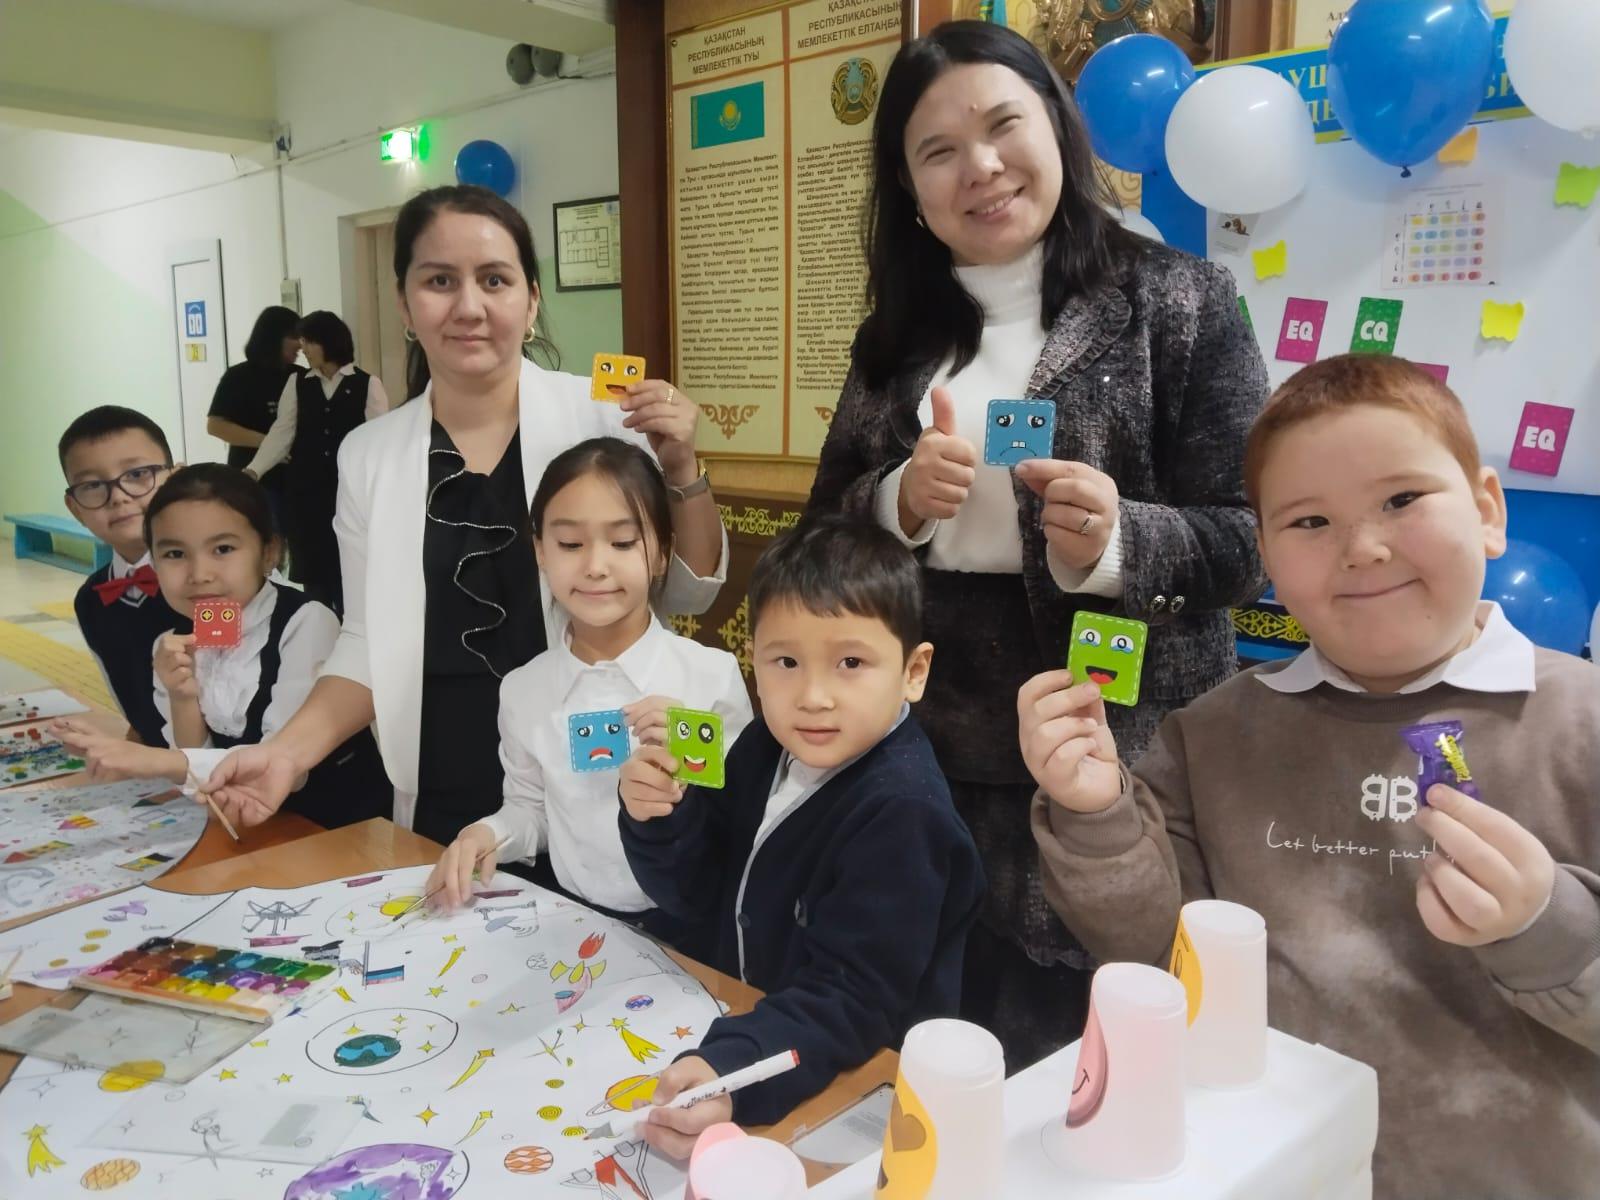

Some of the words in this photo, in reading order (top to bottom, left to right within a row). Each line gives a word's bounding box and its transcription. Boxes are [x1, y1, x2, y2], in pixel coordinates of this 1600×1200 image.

[703, 26, 746, 45] ҚАЗАҚСТАН
[797, 27, 856, 48] МЕМЛЕКЕТТІК
[692, 55, 742, 75] МЕМЛЕКЕТТІК
[744, 51, 760, 62] ТУЫ
[1286, 320, 1313, 342] EQ
[1360, 320, 1388, 342] CQ
[1522, 426, 1555, 451] EQ
[1266, 820, 1304, 850] Let
[1311, 834, 1380, 857] better
